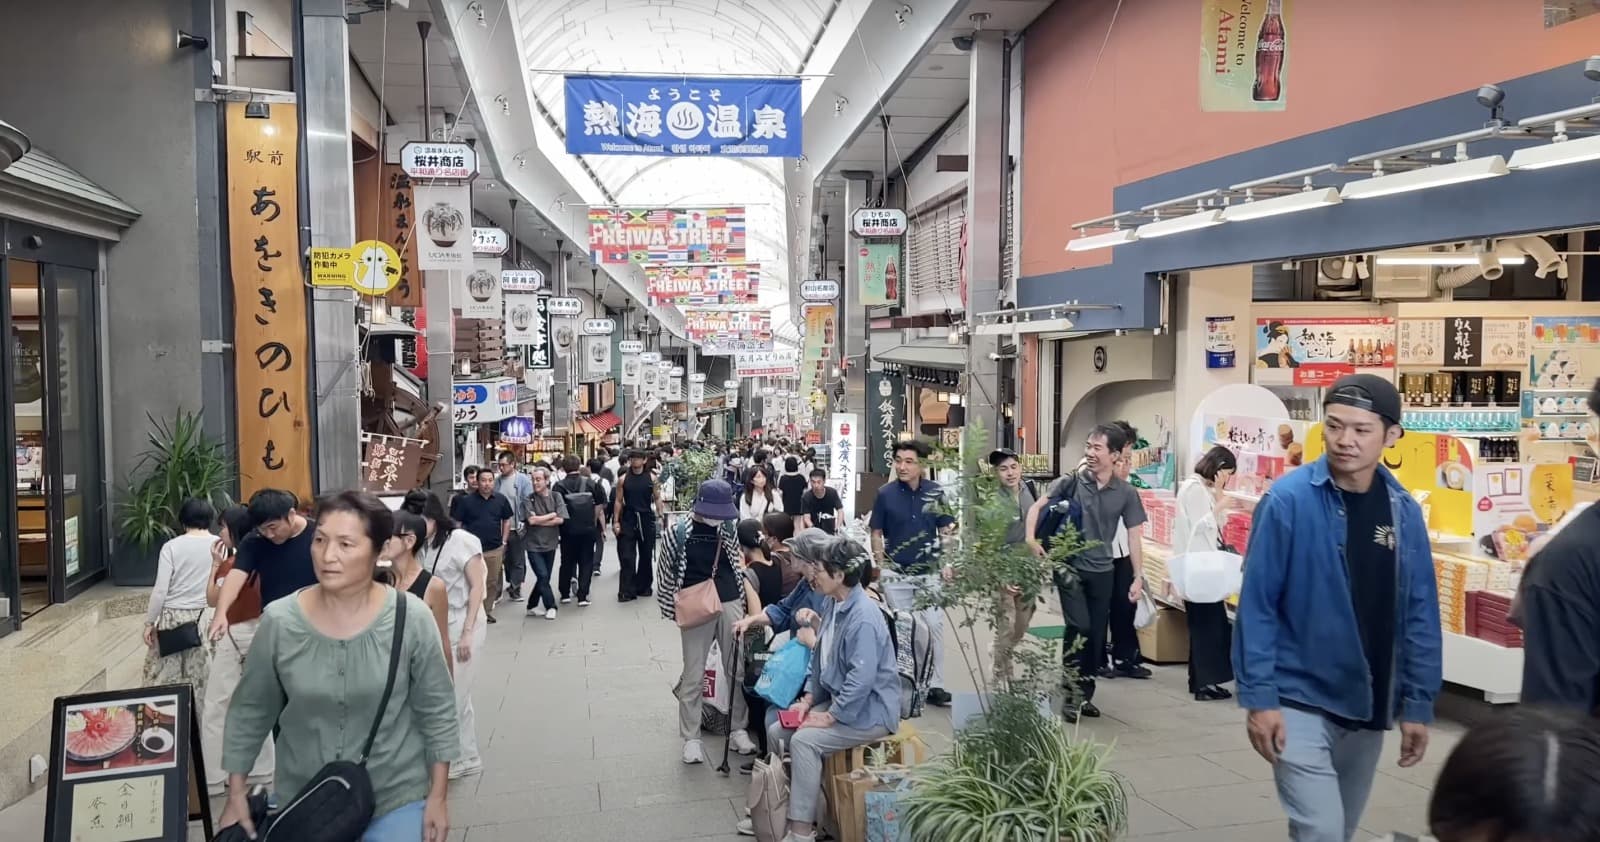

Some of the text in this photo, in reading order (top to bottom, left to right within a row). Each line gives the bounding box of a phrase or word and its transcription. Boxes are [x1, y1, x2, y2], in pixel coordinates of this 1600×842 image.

[1236, 0, 1252, 66] elcome to
[1215, 9, 1235, 74] Atami
[648, 88, 722, 101] ようこそ
[583, 100, 787, 139] 熱海 温泉
[244, 149, 284, 166] 駅前
[414, 155, 464, 167] 桜井商店
[862, 218, 898, 227] 桜井商店
[602, 228, 732, 245] HEIWA STREET
[313, 251, 351, 260] 防犯カメラ
[314, 261, 337, 269] 作動中
[656, 279, 751, 292] HEIWA STREET
[693, 320, 763, 330] HEIWA STREET
[1306, 346, 1345, 358] ビール
